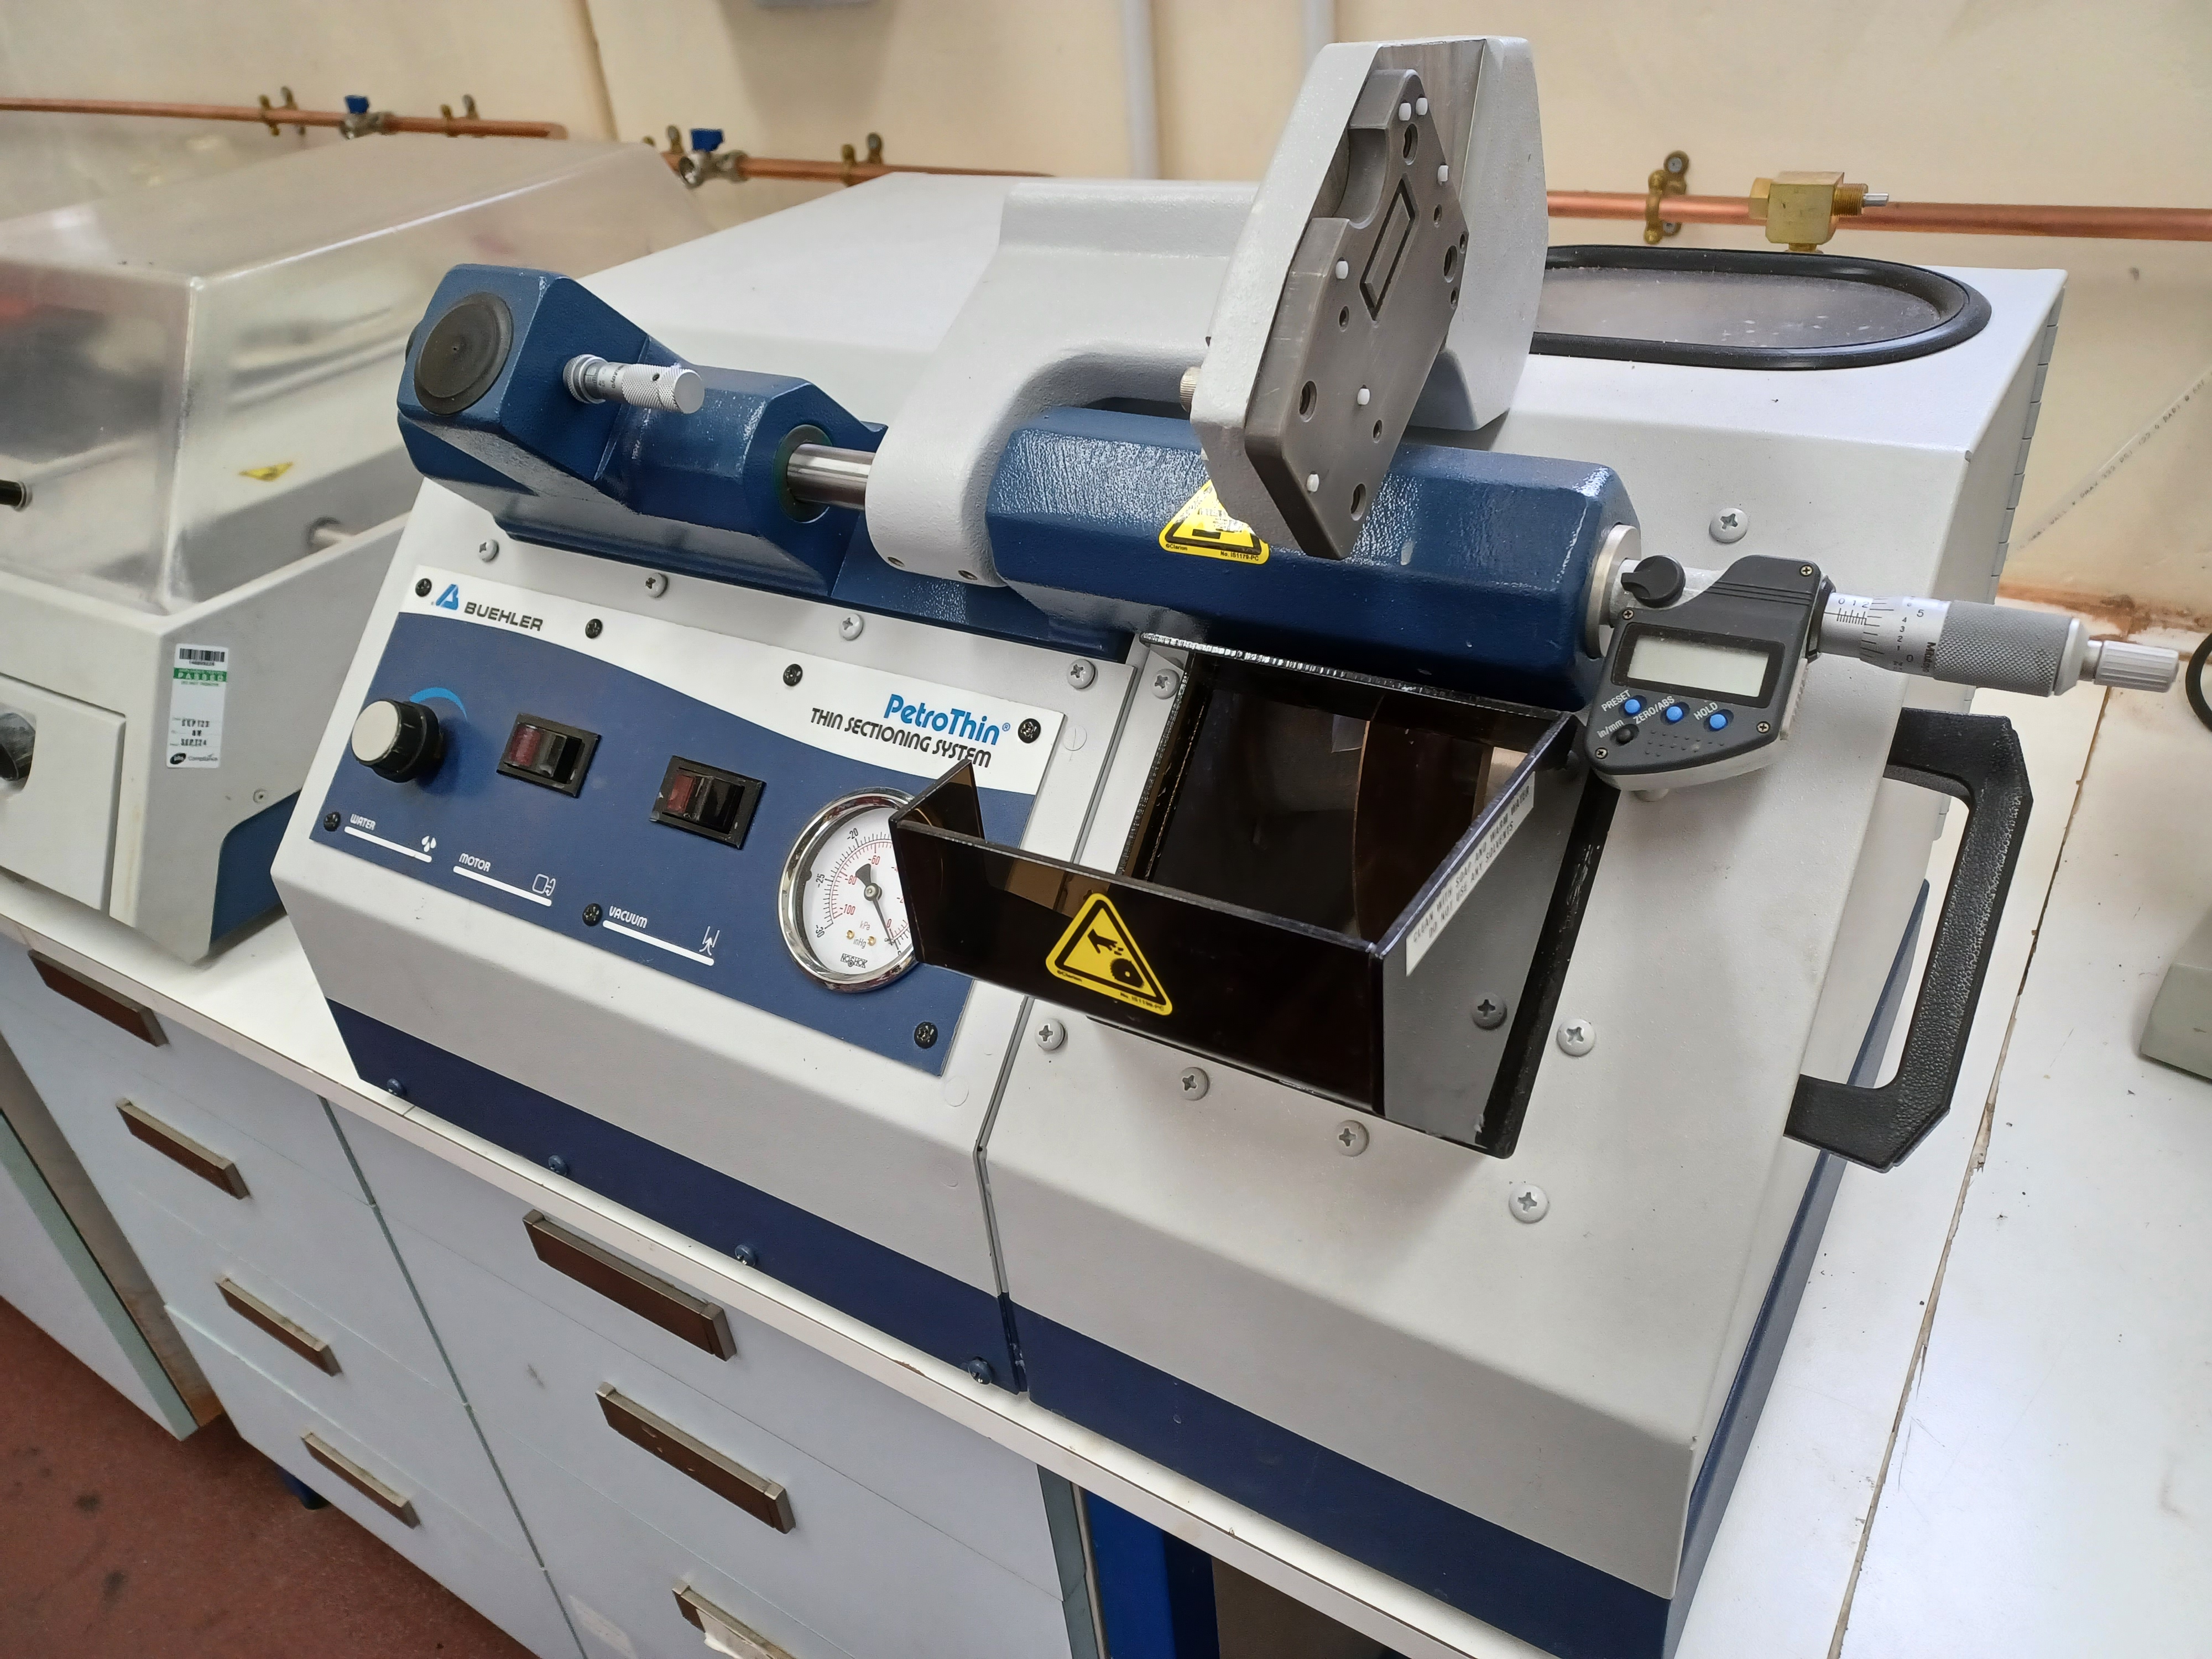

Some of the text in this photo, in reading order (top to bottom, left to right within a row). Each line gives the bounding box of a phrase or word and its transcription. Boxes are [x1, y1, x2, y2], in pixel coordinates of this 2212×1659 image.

[464, 601, 544, 632] BUEHLER
[1916, 609, 1924, 618] 5
[1906, 654, 1914, 663] 0
[1601, 689, 1631, 712] PRESET
[1633, 695, 1675, 725] ZERO/ABS
[1693, 701, 1719, 721] HOLD
[1597, 719, 1624, 739] in/mm
[810, 707, 992, 768] THIN SECTIONING SYSTEM
[349, 813, 377, 831] WATER
[847, 828, 859, 840] -20
[458, 853, 491, 872] MOTOR
[868, 855, 881, 865] -60
[815, 873, 826, 888] -25
[844, 874, 858, 885] -80
[609, 905, 648, 929] VACUUM
[839, 904, 856, 915] -100
[859, 920, 870, 931] kPa
[886, 919, 892, 928] 0
[1429, 921, 1437, 938] DO
[815, 925, 825, 938] -30
[853, 936, 867, 949] inHg
